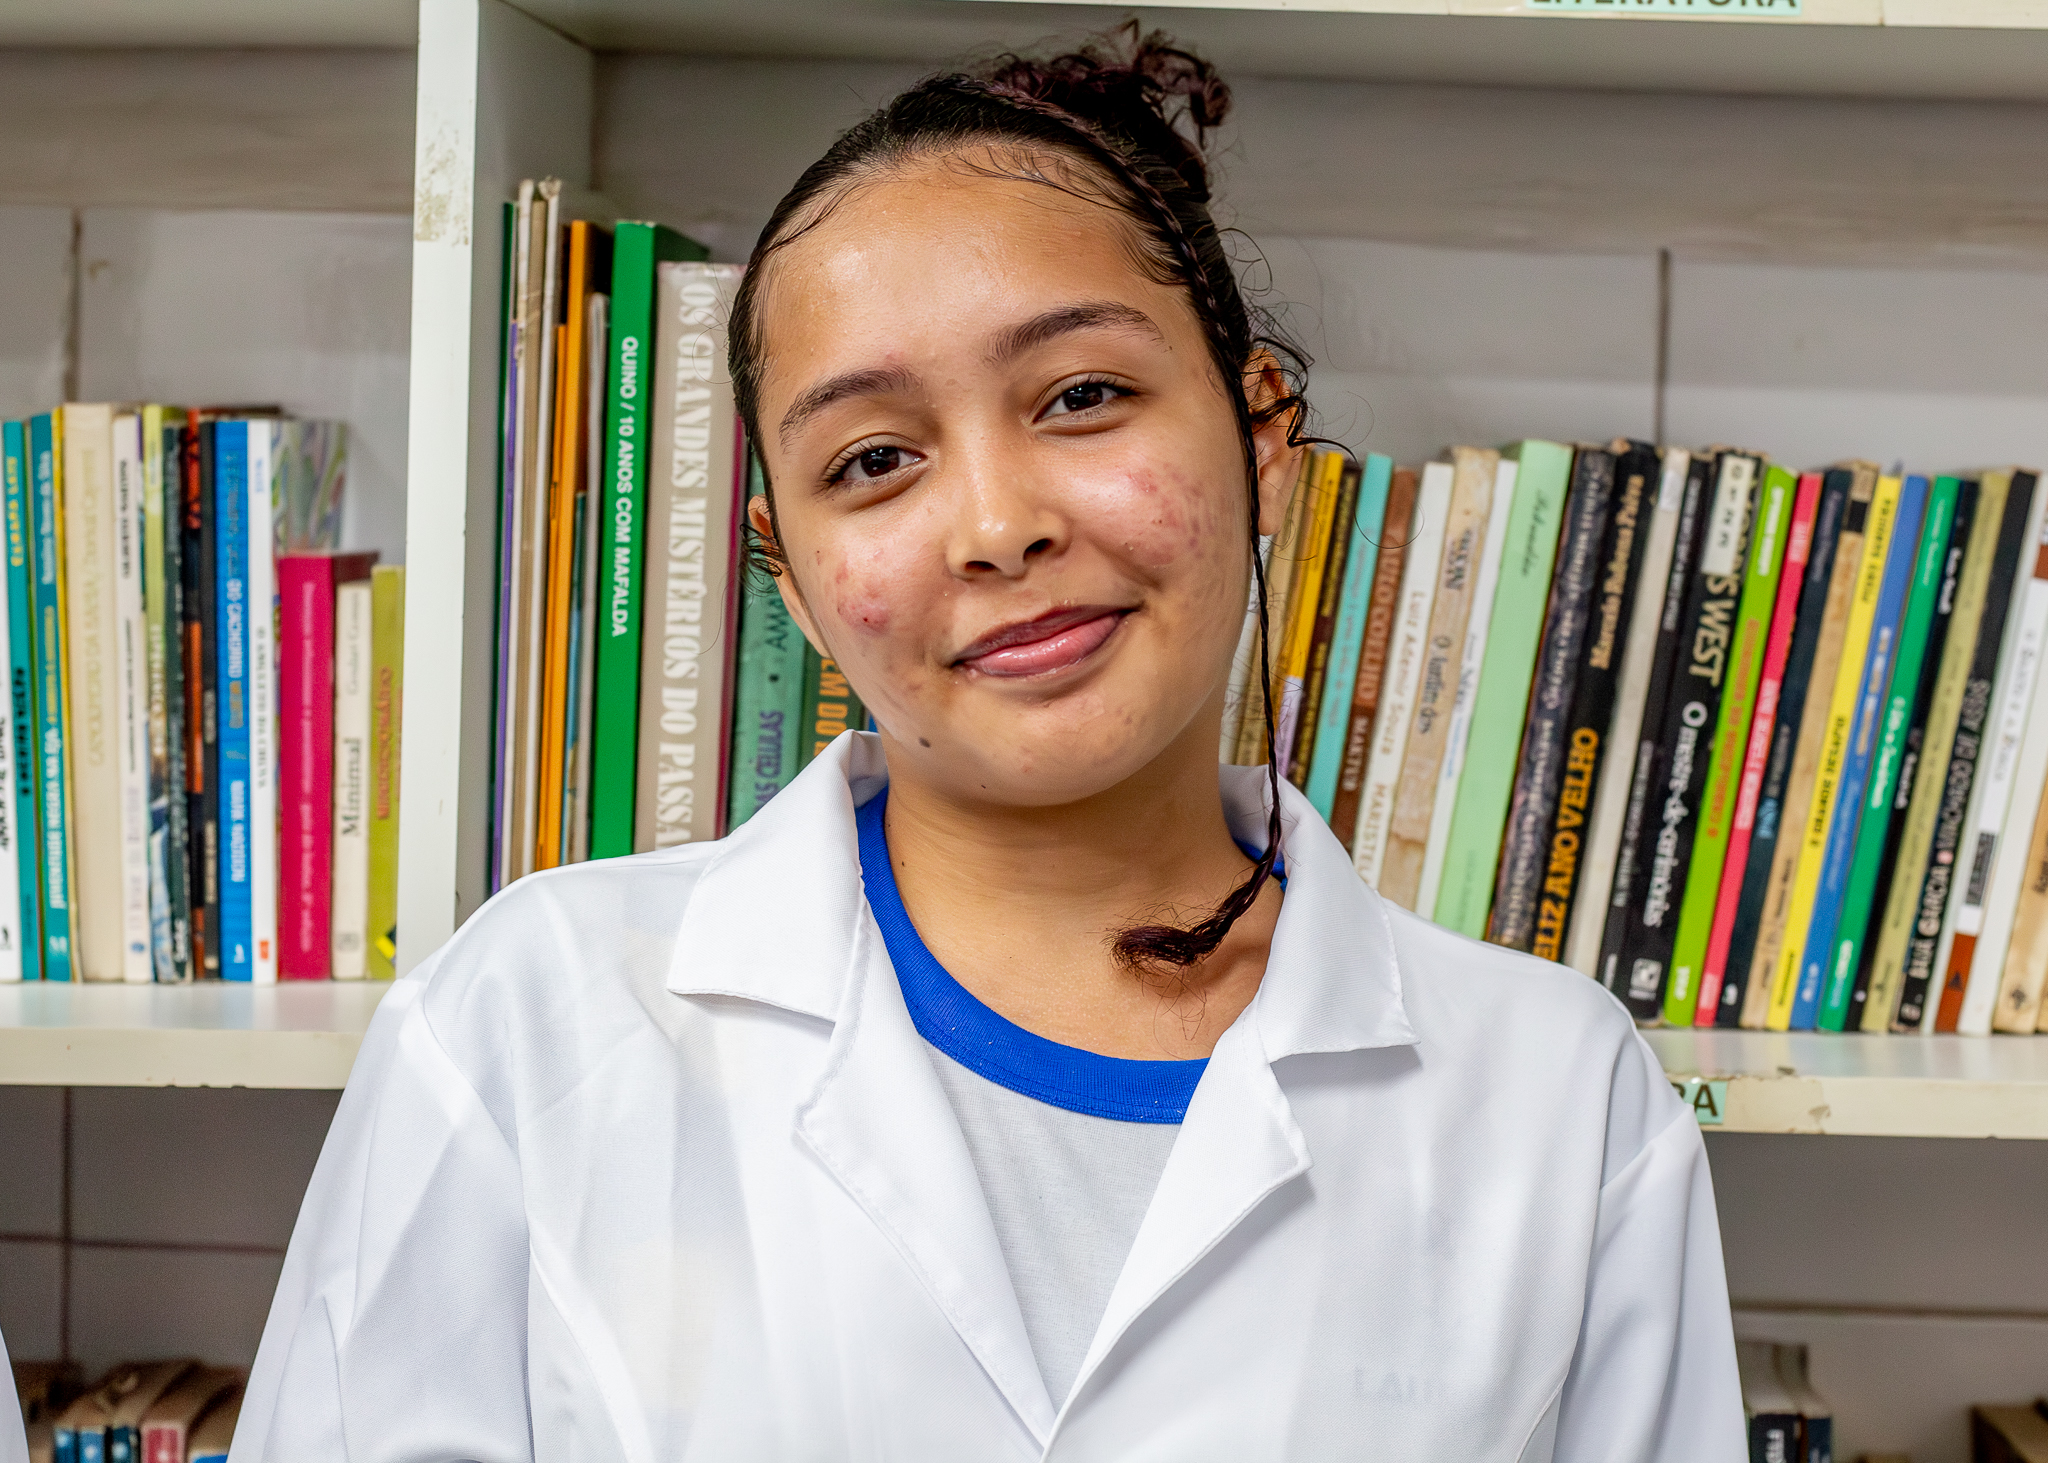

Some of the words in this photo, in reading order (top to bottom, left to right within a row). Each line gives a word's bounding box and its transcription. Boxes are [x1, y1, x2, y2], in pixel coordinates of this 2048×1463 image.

[680, 281, 715, 326] OS
[618, 335, 638, 399] QUINO
[617, 414, 633, 436] 10
[673, 332, 714, 489] GRANDES
[616, 439, 634, 493] ANOS
[614, 496, 632, 543] COM
[610, 547, 630, 637] MAFALDA
[660, 495, 707, 680] MISTÉRIOS
[1354, 603, 1392, 705] COELHO
[1682, 592, 1740, 688] WEST
[658, 686, 695, 734] DO
[1679, 698, 1710, 730] O
[341, 738, 361, 836] Minimal
[1341, 713, 1370, 792] MAKTUB
[1554, 724, 1601, 832] VELHO
[654, 742, 694, 848] PASSA
[1353, 781, 1388, 885] MARISTEL
[1543, 830, 1581, 899] ANO
[1915, 865, 1951, 938] GARCIA
[1531, 898, 1567, 962] ELIZ
